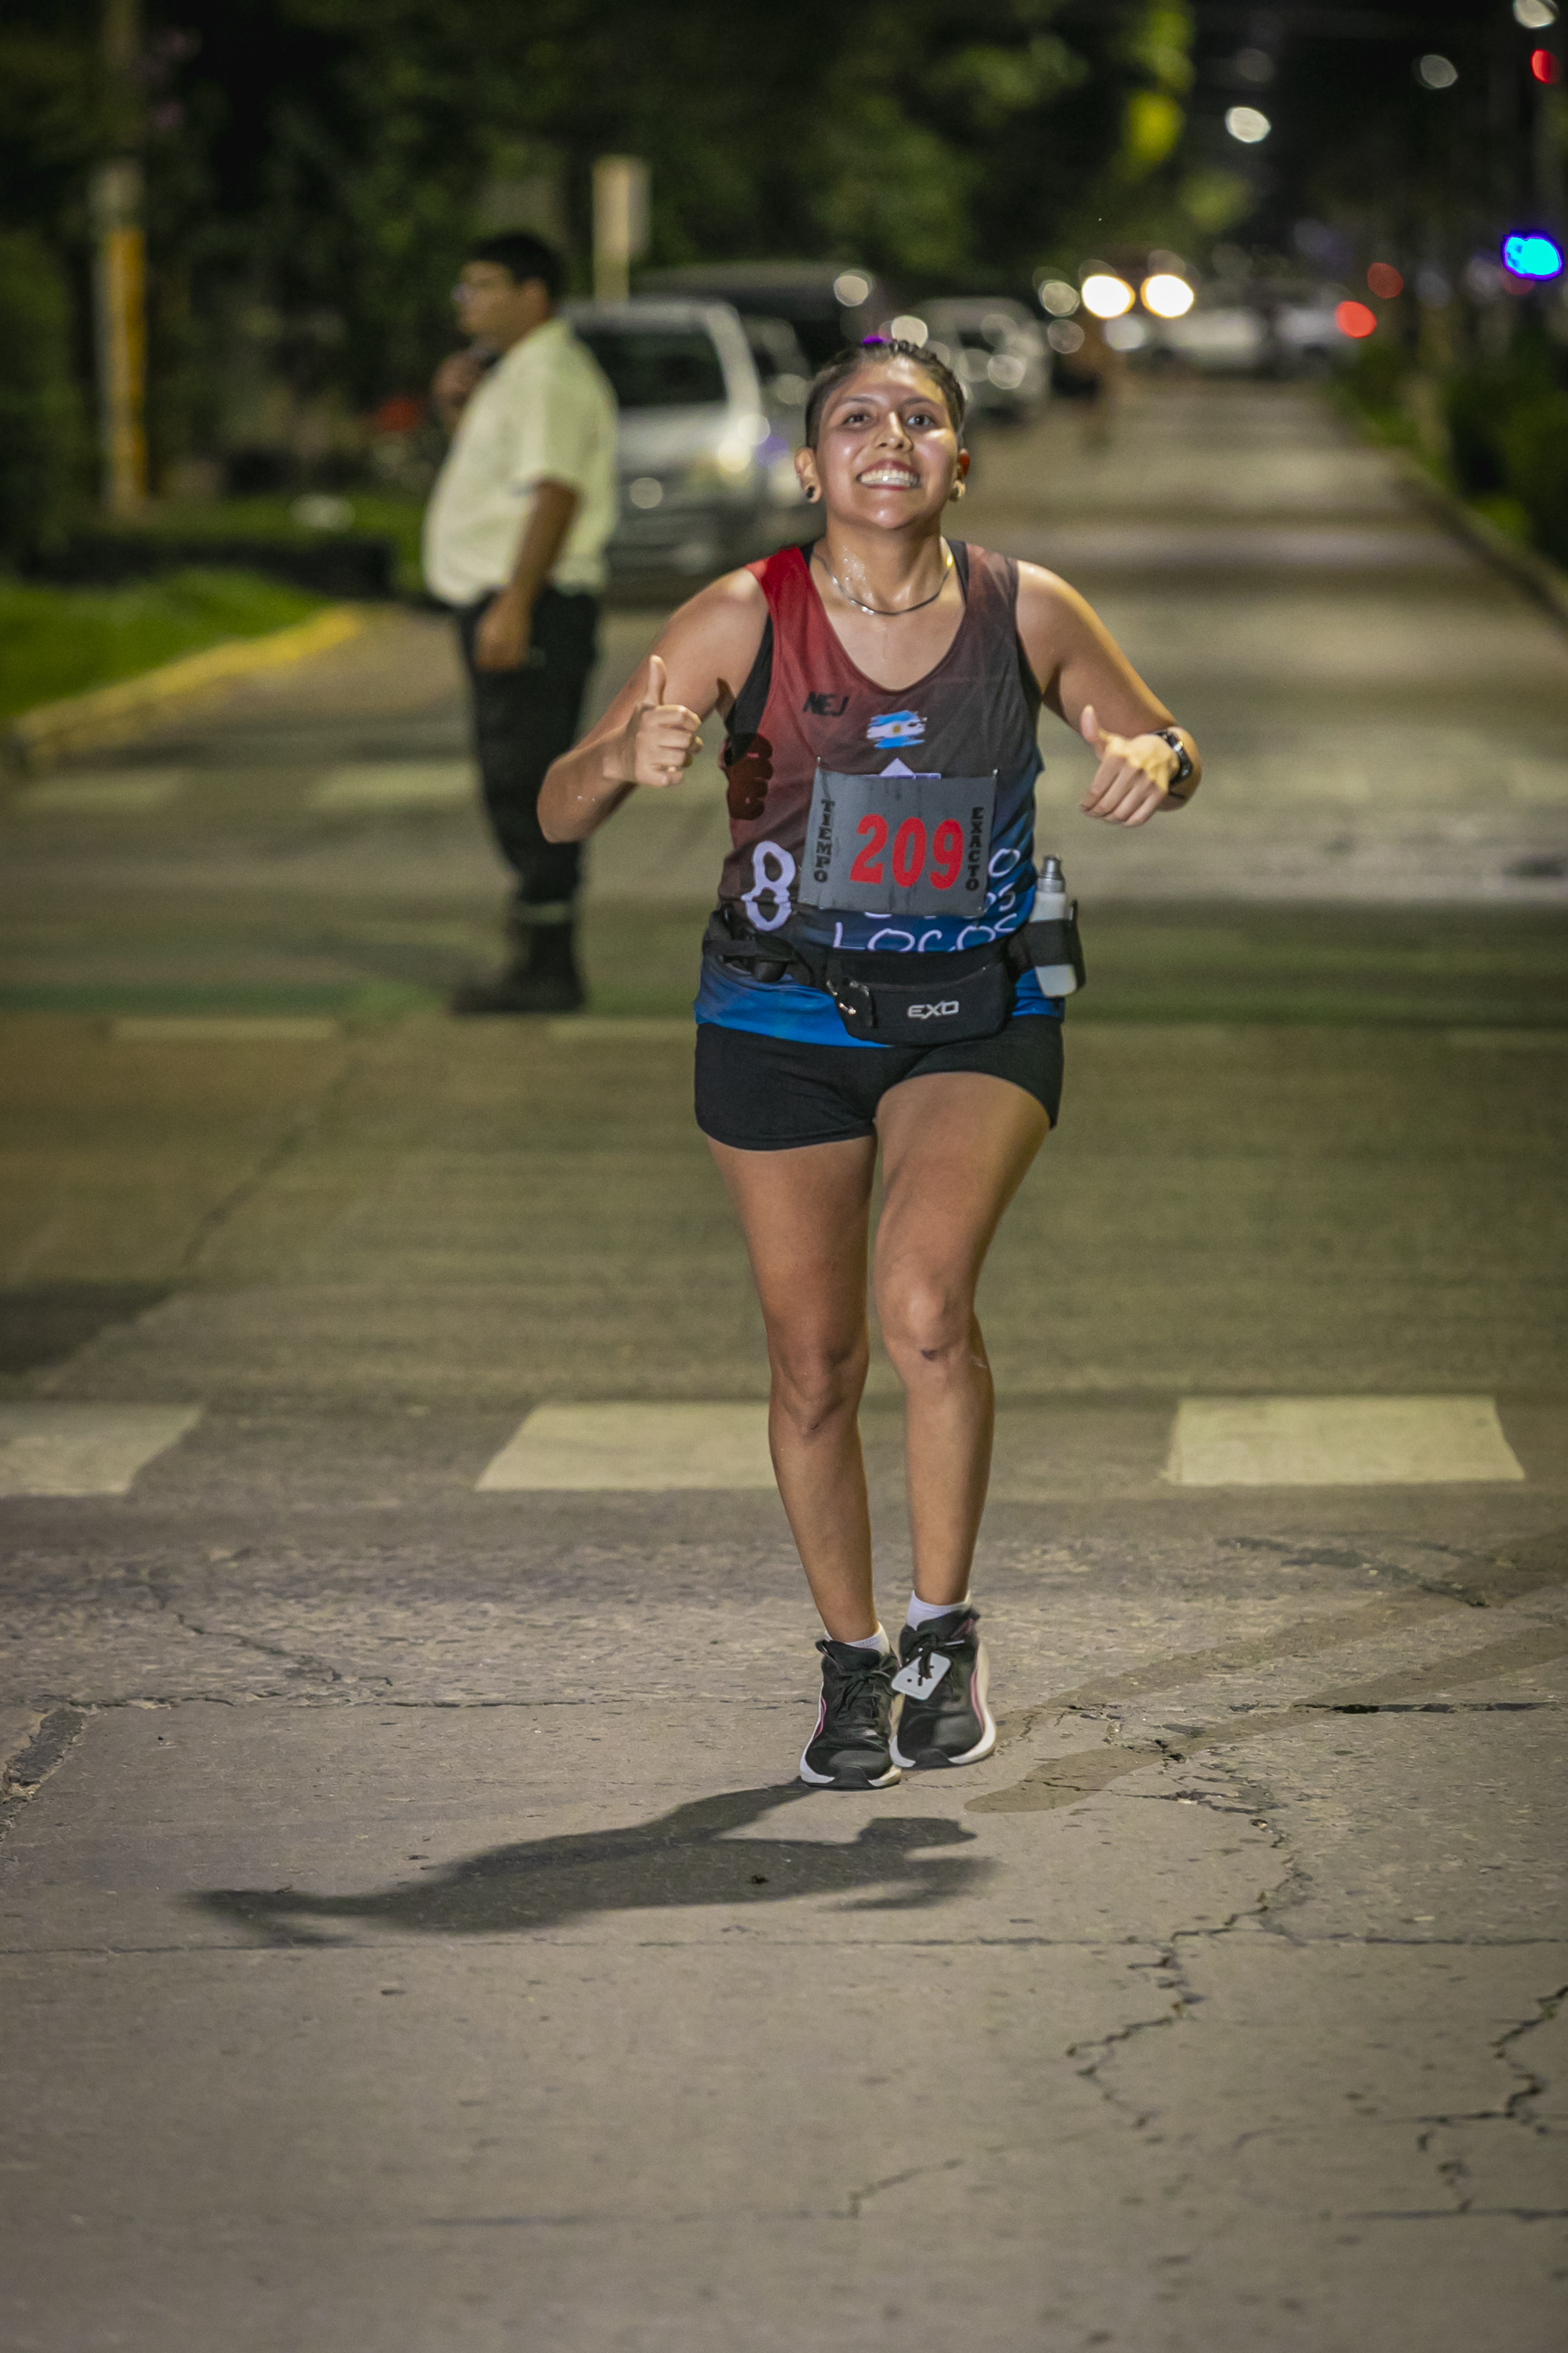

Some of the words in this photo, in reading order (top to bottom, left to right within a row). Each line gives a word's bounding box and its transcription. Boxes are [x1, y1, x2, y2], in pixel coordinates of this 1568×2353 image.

[814, 798, 836, 883] TIEMPO
[849, 813, 964, 890] 209
[966, 806, 984, 892] EXACTO
[907, 1000, 960, 1021] EXO
